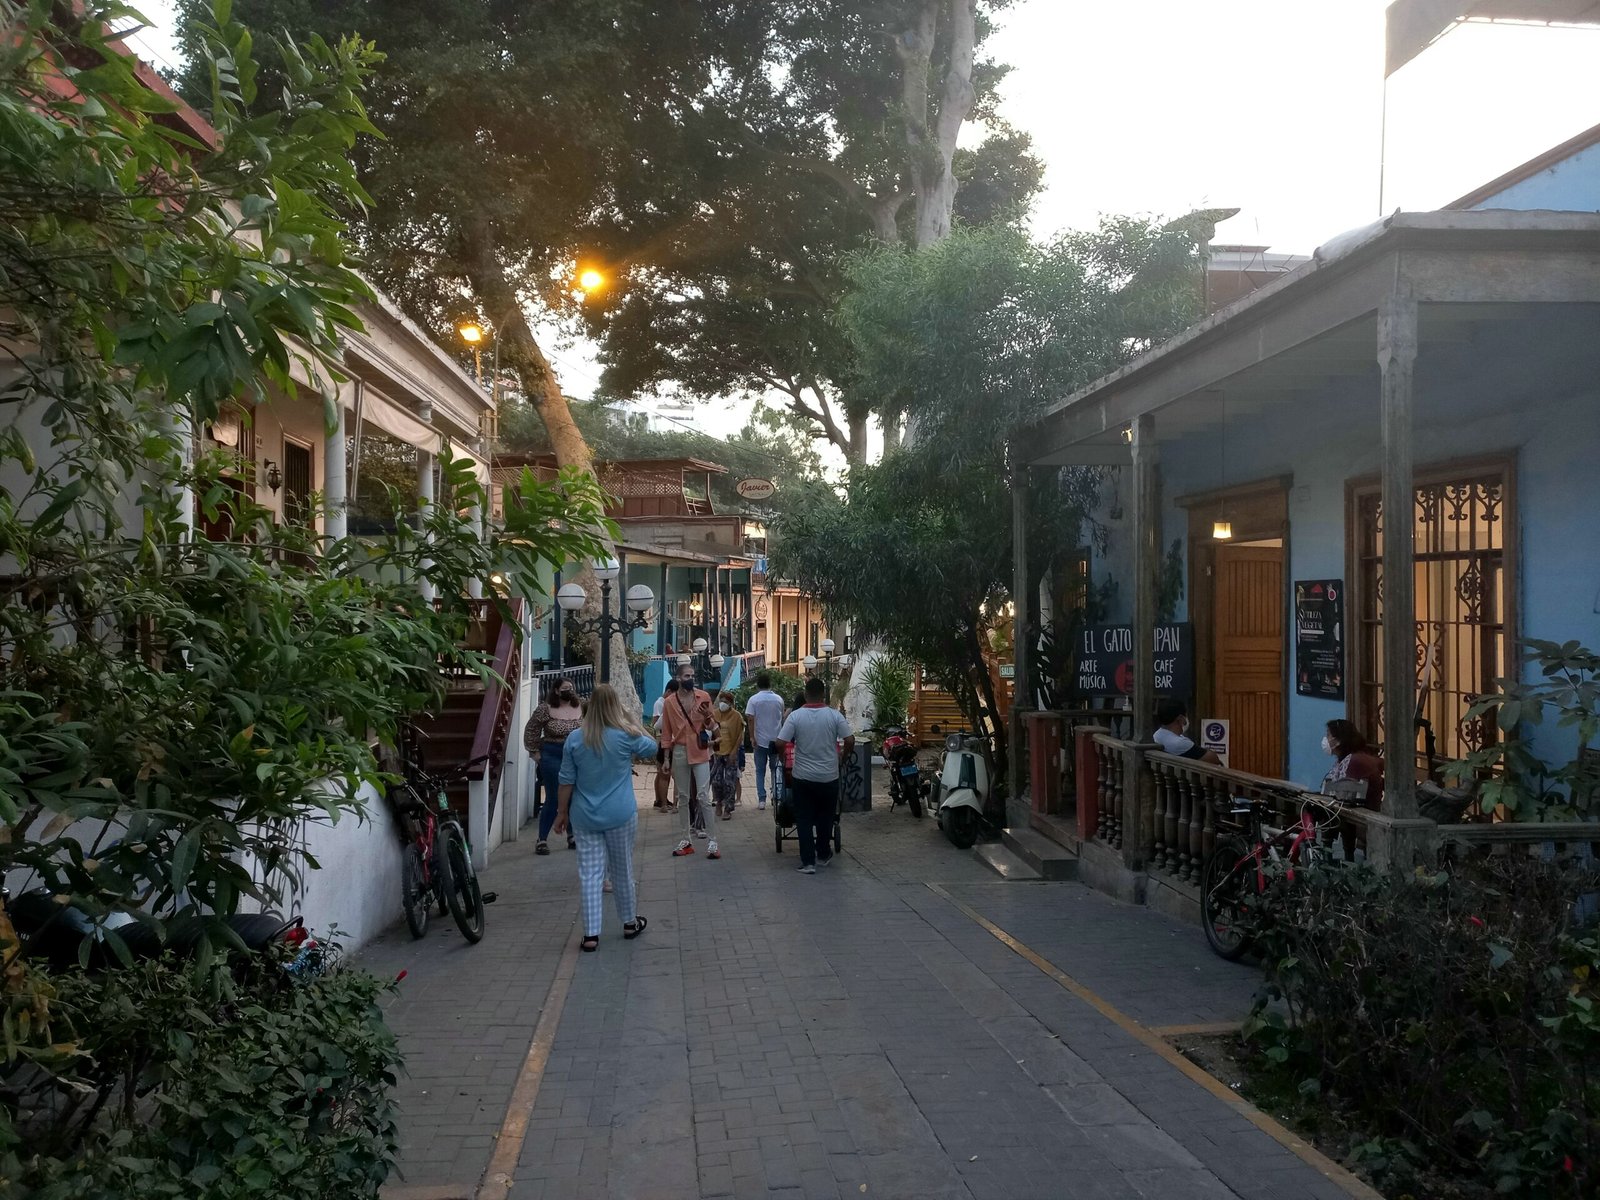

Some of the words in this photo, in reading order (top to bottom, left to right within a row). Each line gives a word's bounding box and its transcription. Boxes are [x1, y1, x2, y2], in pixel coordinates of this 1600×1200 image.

[741, 482, 769, 495] Javier
[1084, 630, 1096, 654] EL
[1103, 628, 1132, 653] GATO
[1079, 659, 1098, 673] ARTE
[1153, 657, 1176, 674] CAFÉ
[1079, 673, 1107, 690] MÚSICA
[1154, 675, 1173, 689] BAR
